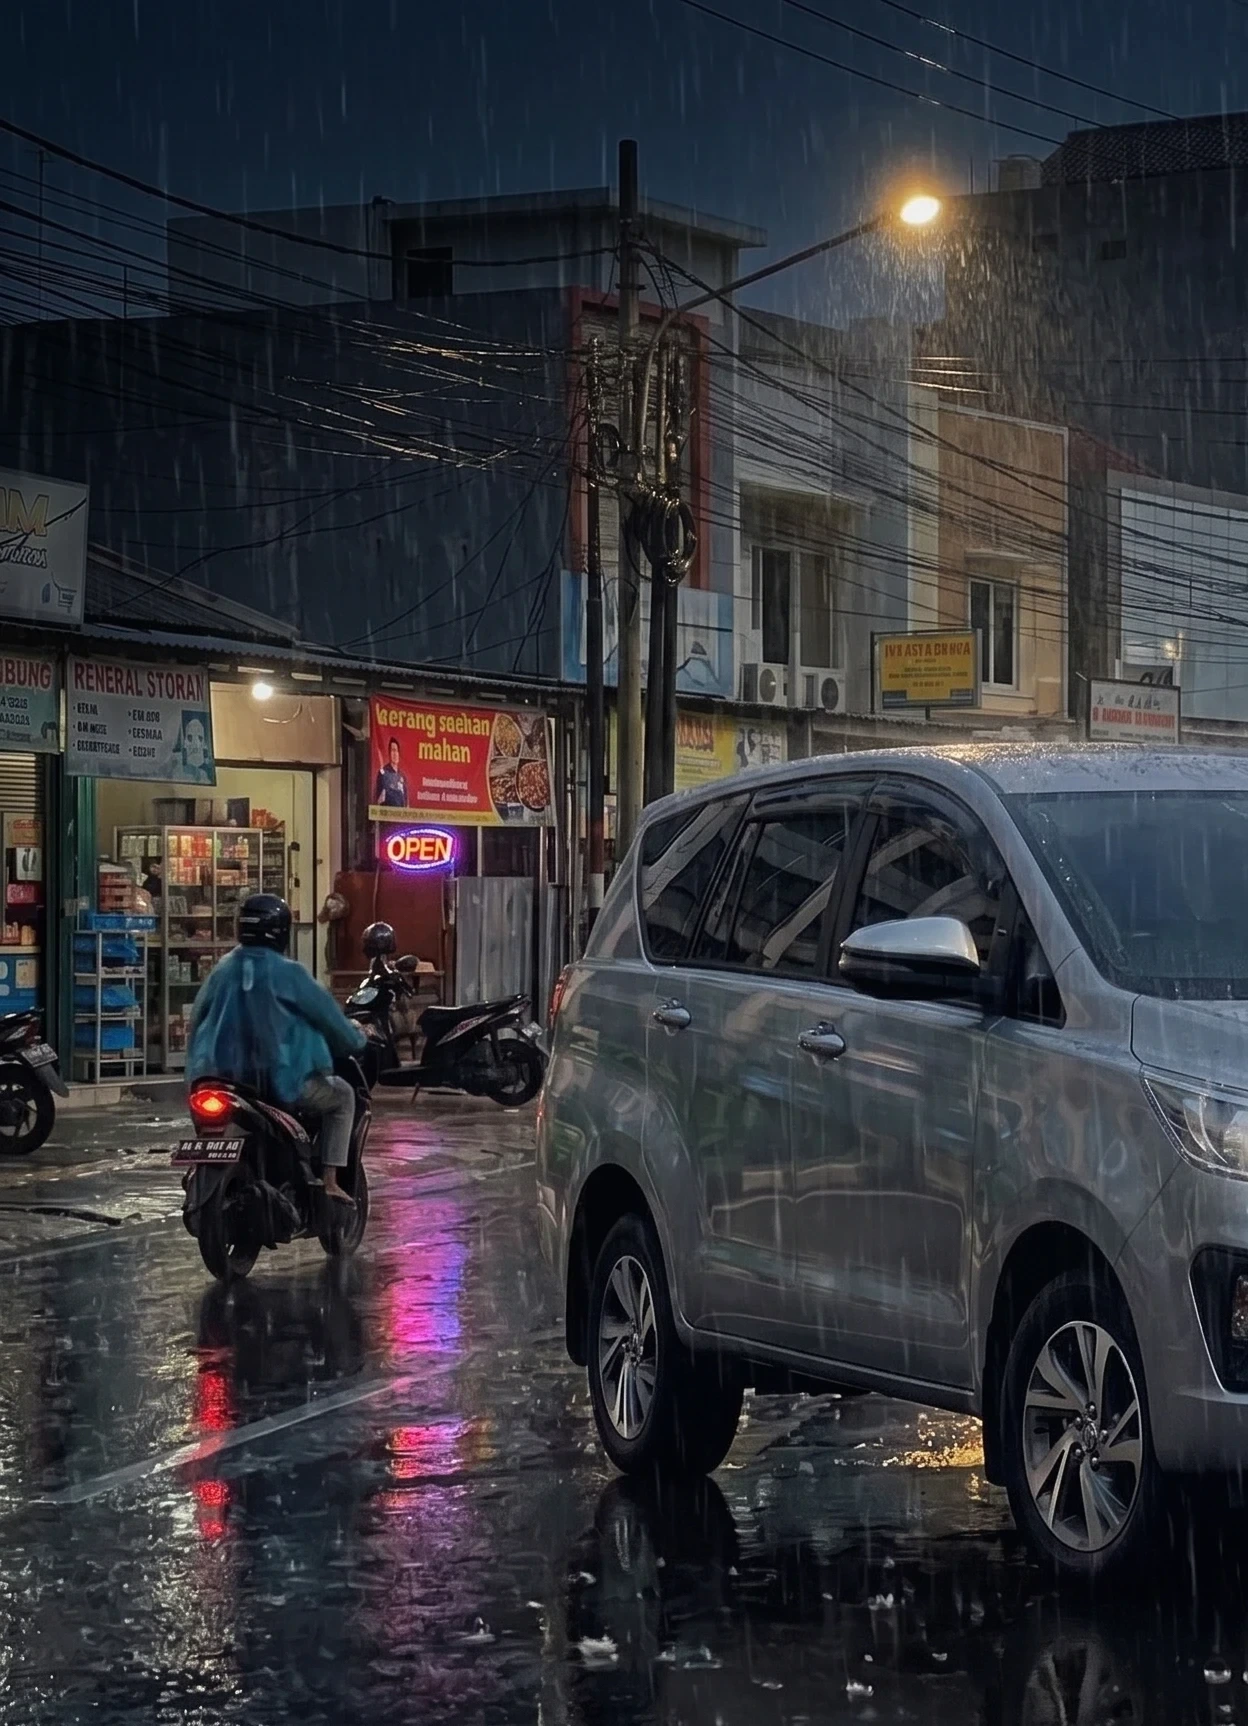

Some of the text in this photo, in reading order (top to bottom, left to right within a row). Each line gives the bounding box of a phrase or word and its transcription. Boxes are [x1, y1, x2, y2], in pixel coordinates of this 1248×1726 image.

[74, 662, 143, 697] RENERAL
[418, 737, 471, 763] mahan
[387, 837, 449, 861] OPEN
